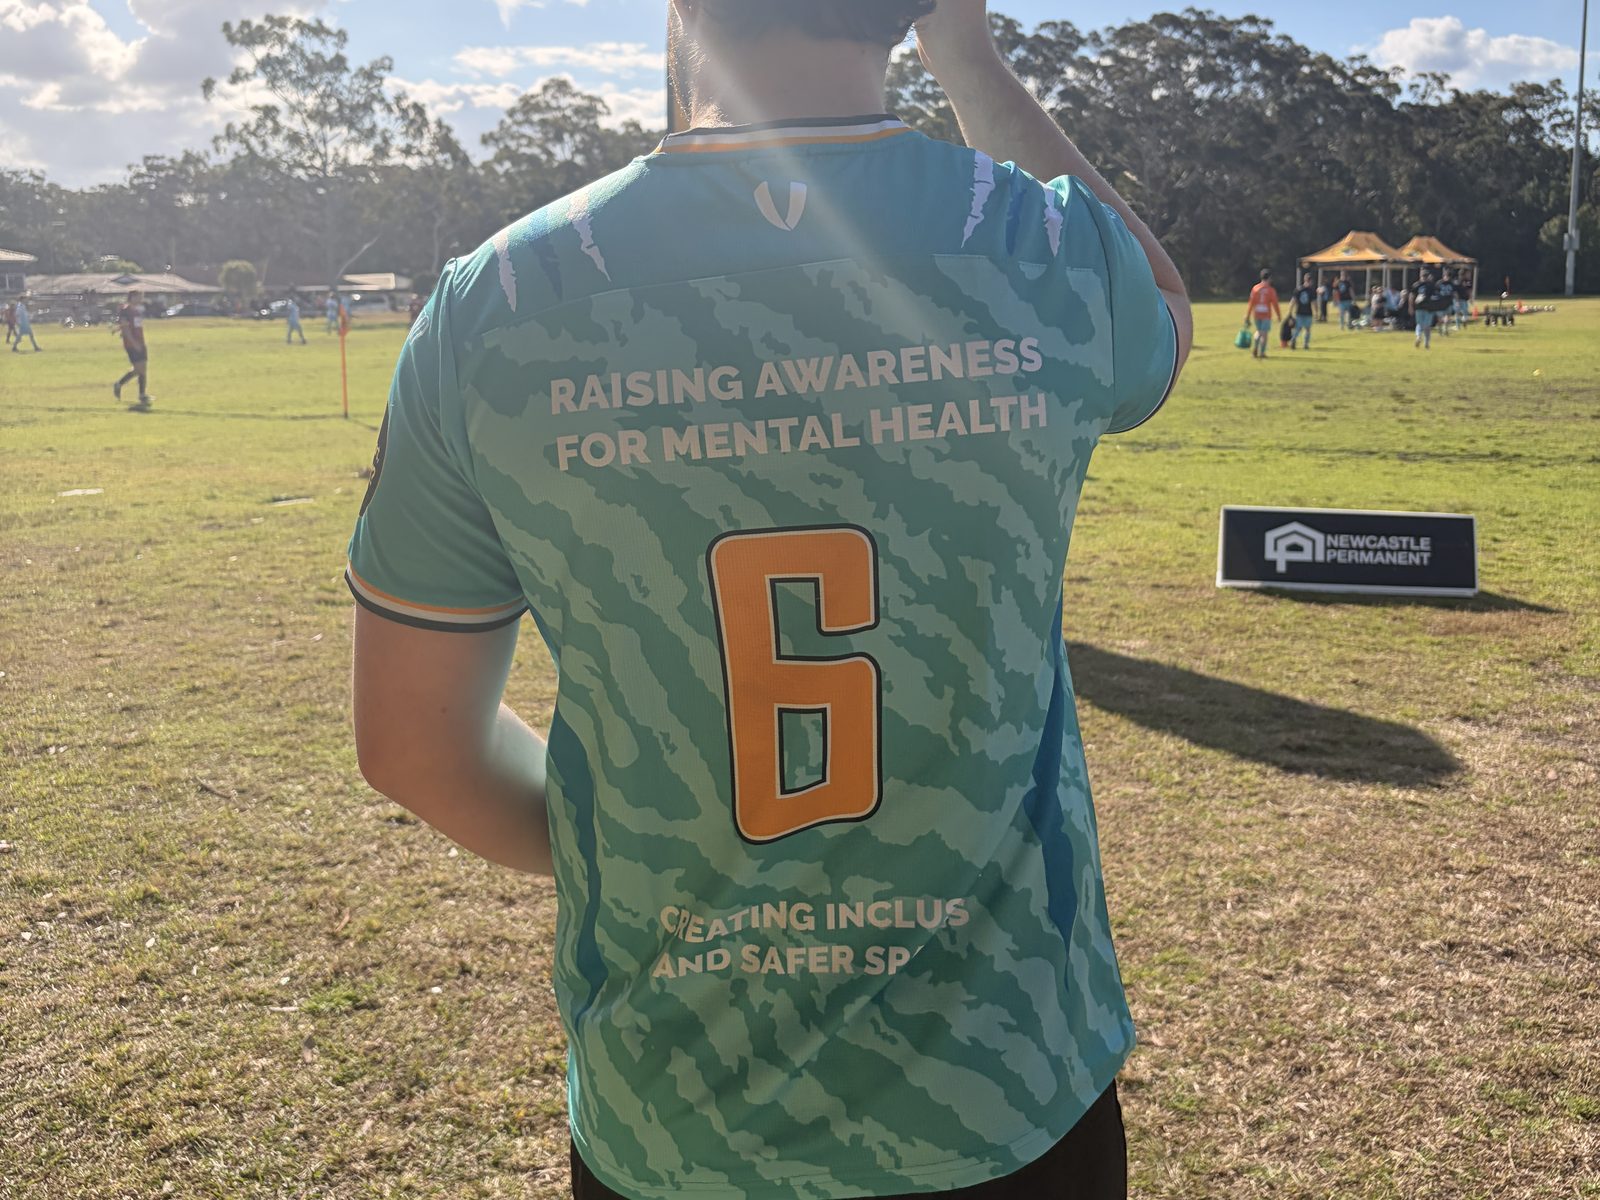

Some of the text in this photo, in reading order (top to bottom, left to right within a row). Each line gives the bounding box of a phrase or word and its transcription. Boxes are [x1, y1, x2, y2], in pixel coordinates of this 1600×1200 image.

[550, 337, 1043, 415] RAISING AWARENESS
[556, 393, 1047, 471] FOR MENTAL HEALTH
[1326, 533, 1432, 550] NEWCASTLE
[1326, 548, 1432, 565] PERMANENT
[706, 523, 883, 845] 6
[659, 901, 815, 943] CREATING
[652, 944, 925, 979] AND SAFER SP
